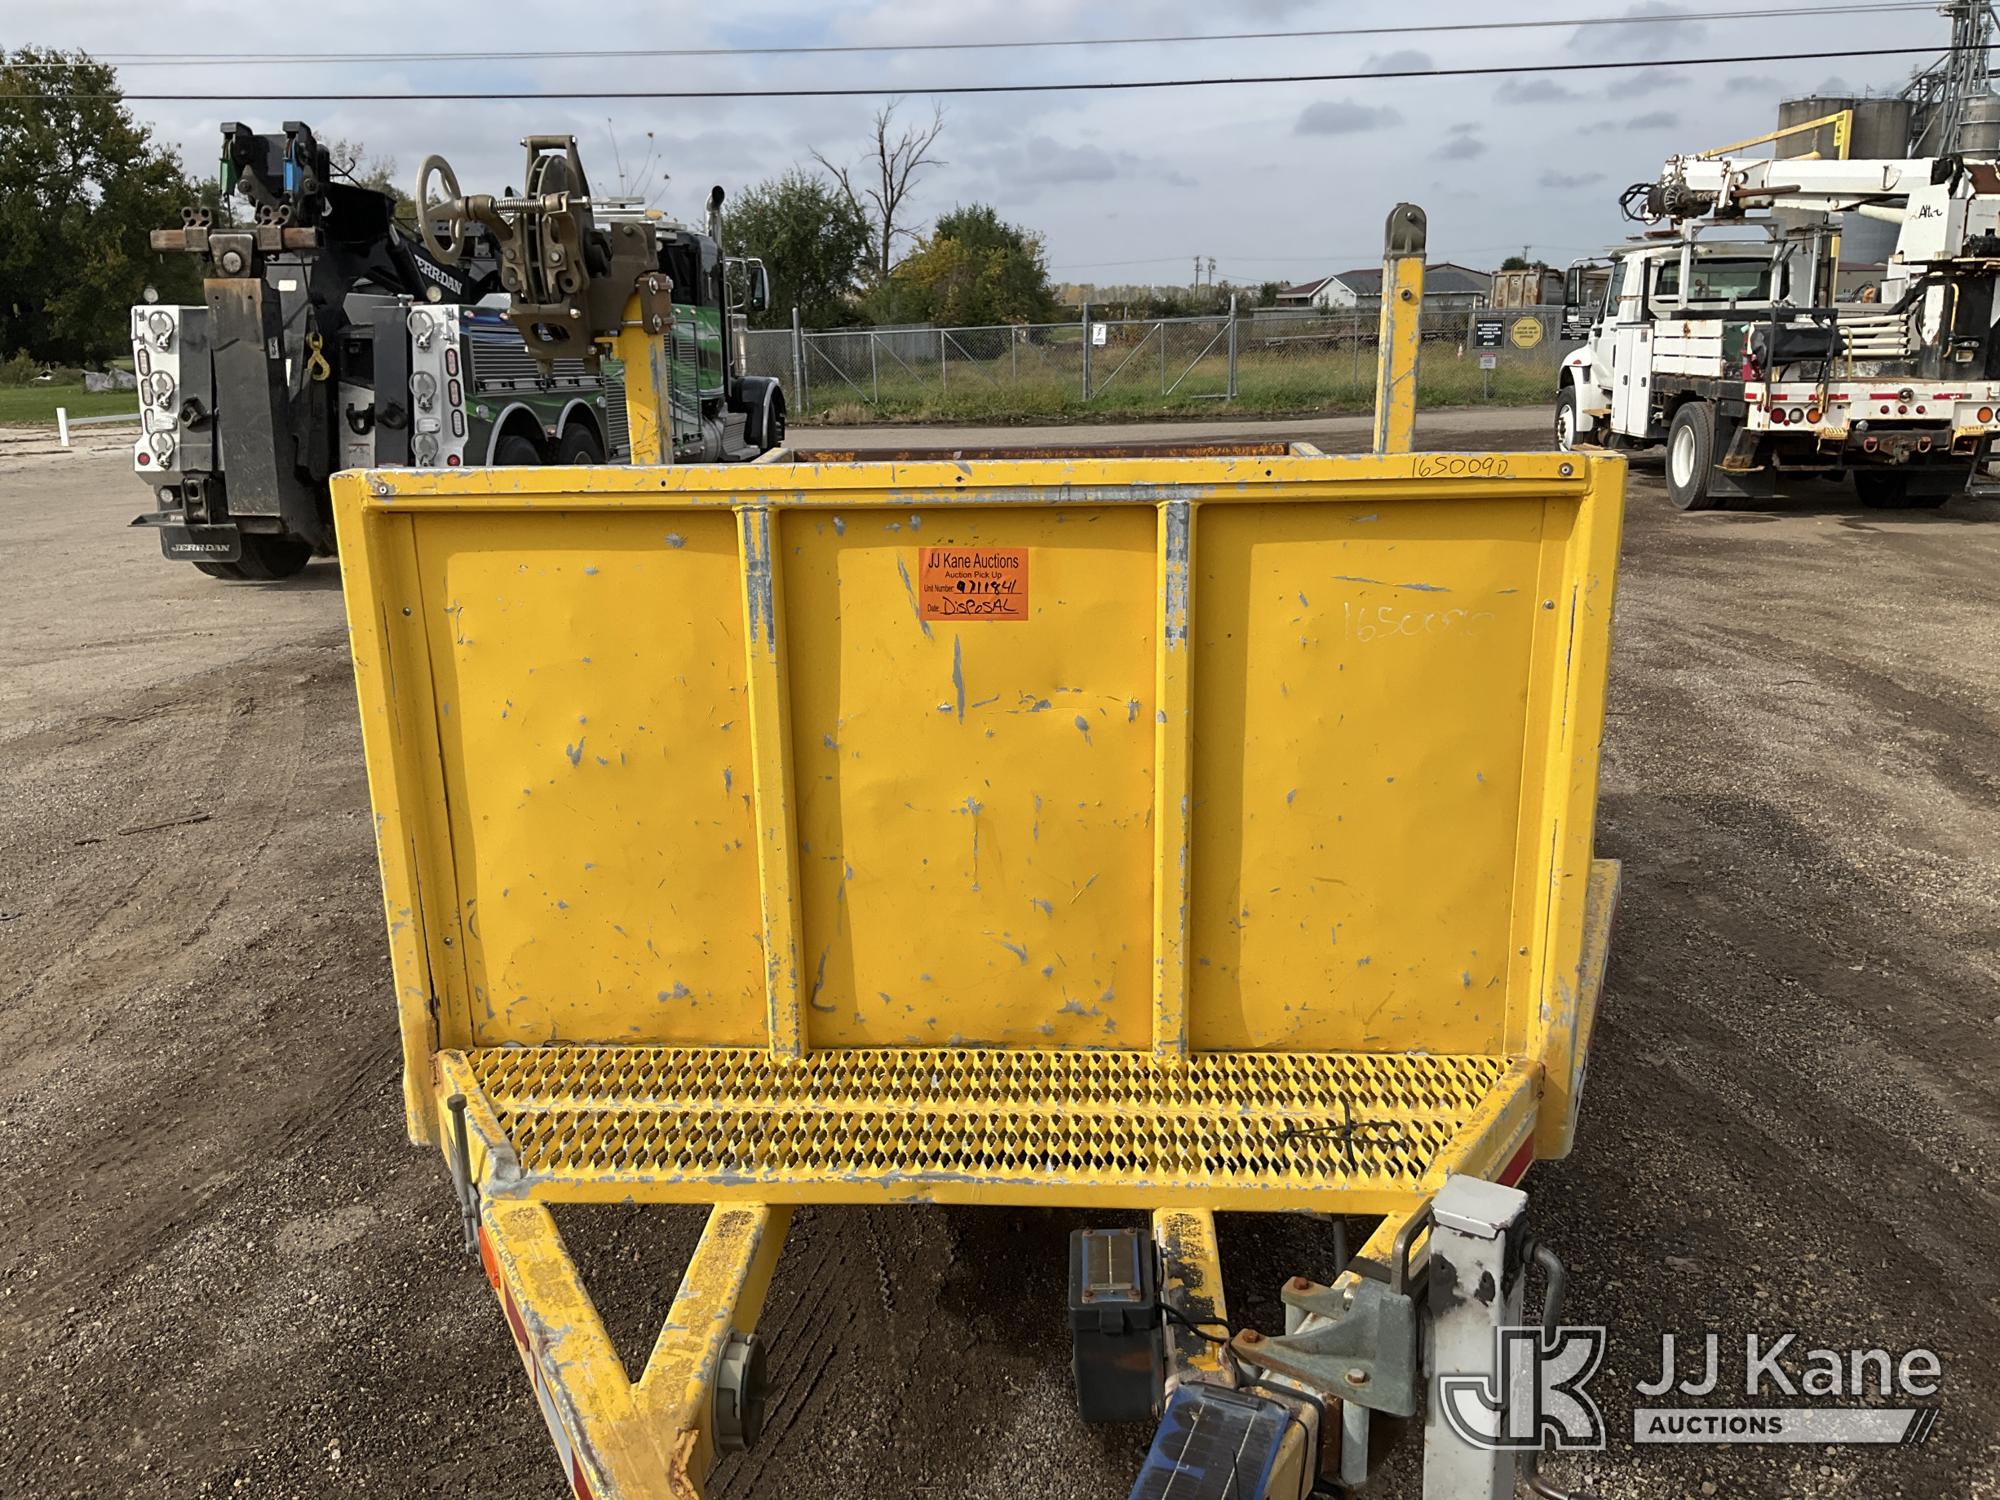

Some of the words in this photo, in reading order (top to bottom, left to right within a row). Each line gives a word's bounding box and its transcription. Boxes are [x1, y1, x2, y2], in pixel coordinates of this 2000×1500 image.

[928, 553, 940, 569] JJ
[943, 553, 971, 569] Kane
[973, 553, 1019, 569] Auctions
[945, 571, 972, 579] Auction
[974, 571, 989, 579] Pick
[991, 571, 1002, 580] Up
